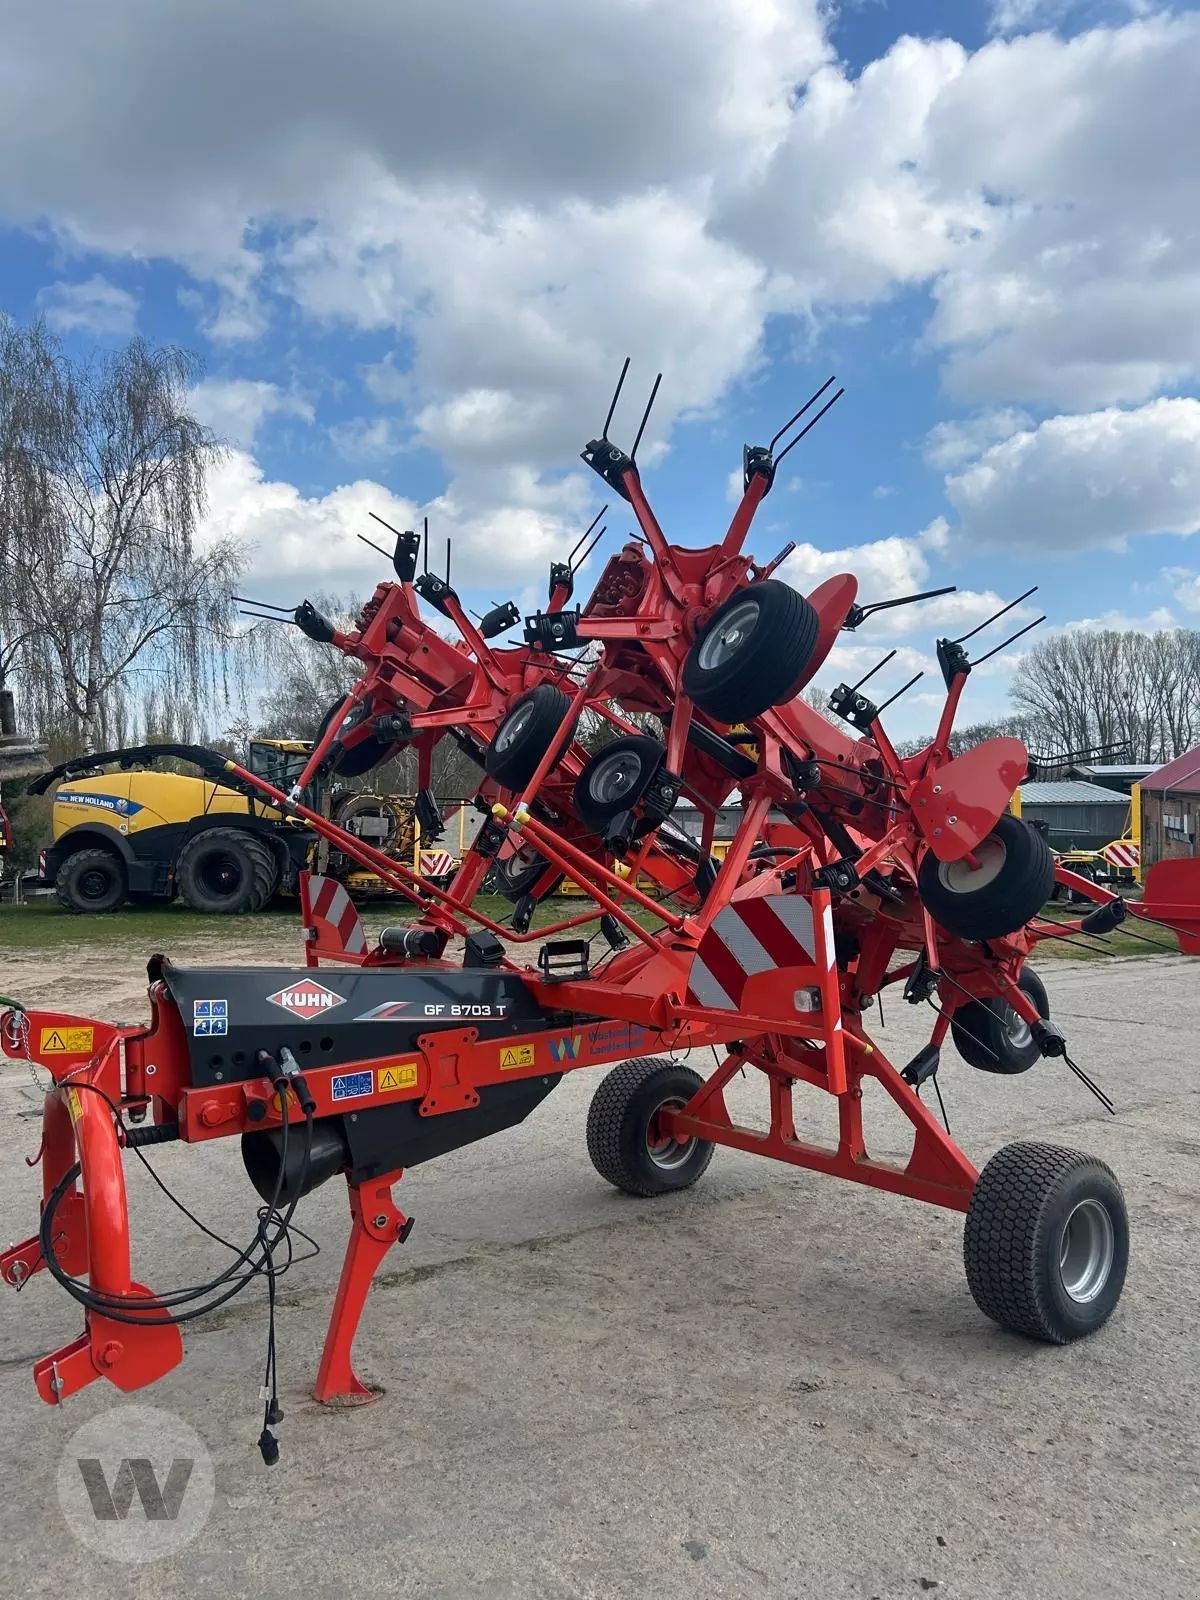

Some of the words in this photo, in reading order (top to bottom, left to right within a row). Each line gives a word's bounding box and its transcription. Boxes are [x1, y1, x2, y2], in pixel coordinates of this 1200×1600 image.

[70, 795, 84, 803] NEW
[85, 796, 115, 809] HOLLAND
[281, 992, 333, 1007] KUHN
[424, 1004, 446, 1016] GF
[450, 1004, 492, 1016] 8703
[495, 1005, 507, 1016] T
